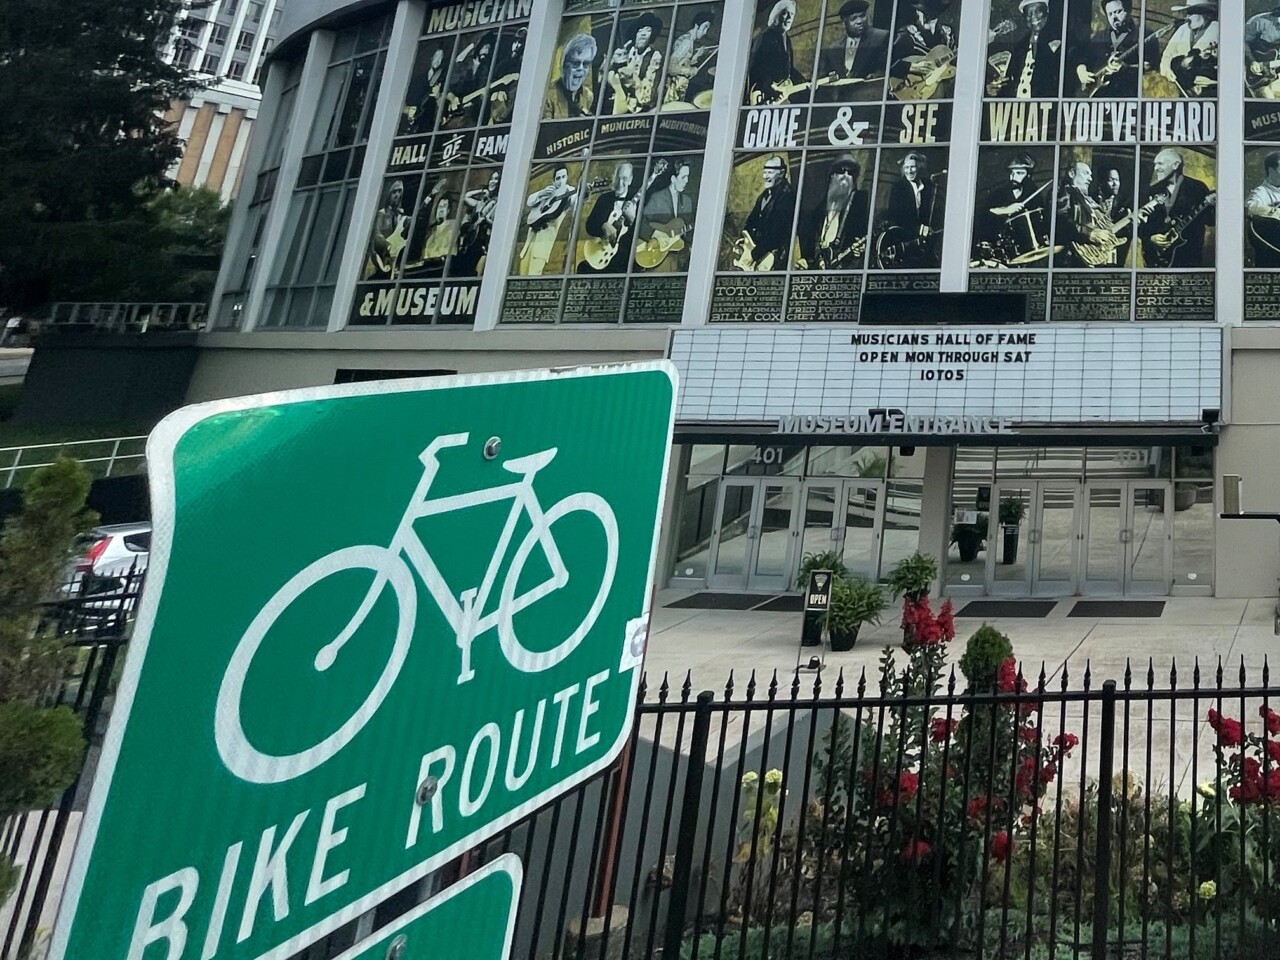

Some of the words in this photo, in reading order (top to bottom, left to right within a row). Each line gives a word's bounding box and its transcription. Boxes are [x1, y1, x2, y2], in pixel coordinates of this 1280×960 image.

[743, 106, 800, 148] COME
[827, 106, 869, 145] &
[900, 103, 938, 143] SEE
[989, 101, 1053, 142] WHAT
[1062, 101, 1137, 142] YOU'VE
[1145, 101, 1216, 142] HEARD
[546, 129, 590, 156] HISTORIC
[601, 119, 651, 134] MUNICIPAL
[391, 144, 427, 166] HALL
[443, 140, 462, 159] OF
[476, 135, 510, 157] FAM
[792, 276, 818, 284] BEN
[822, 276, 861, 284] KEITH
[970, 277, 1017, 285] BUDDY
[1018, 277, 1047, 285] GUY
[569, 281, 624, 290] ALABAMA
[868, 281, 910, 290] BILLY
[912, 281, 939, 289] COX
[1245, 285, 1270, 294] DON
[507, 291, 525, 300] DON
[526, 290, 561, 300] EVERLY
[630, 290, 656, 298] THE
[716, 286, 757, 296] TOTO
[1053, 286, 1096, 295] WILL
[1099, 286, 1130, 295] LEE
[1136, 286, 1171, 295] THE
[567, 293, 591, 301] RICKY
[789, 291, 808, 300] AL
[810, 291, 860, 299] KOOPER
[1136, 296, 1214, 305] CRICKETS
[787, 306, 816, 314] FRED
[1052, 303, 1078, 311] THE
[711, 313, 752, 321] BILLY
[754, 313, 781, 321] COX
[850, 333, 929, 345] MUSICIANS
[935, 333, 971, 345] HALL
[975, 333, 994, 345] OF
[998, 333, 1037, 345] FAME
[859, 351, 899, 363] OPEN
[905, 351, 934, 362] MON
[938, 351, 999, 362] THROUGH
[1003, 351, 1032, 362] SAT
[778, 415, 882, 433] MUSEUM
[889, 415, 1013, 433] ENTRANCE
[750, 447, 784, 464] 401
[809, 594, 827, 605] OPEN
[127, 784, 367, 960] BIKE
[404, 669, 609, 849] ROUTE
